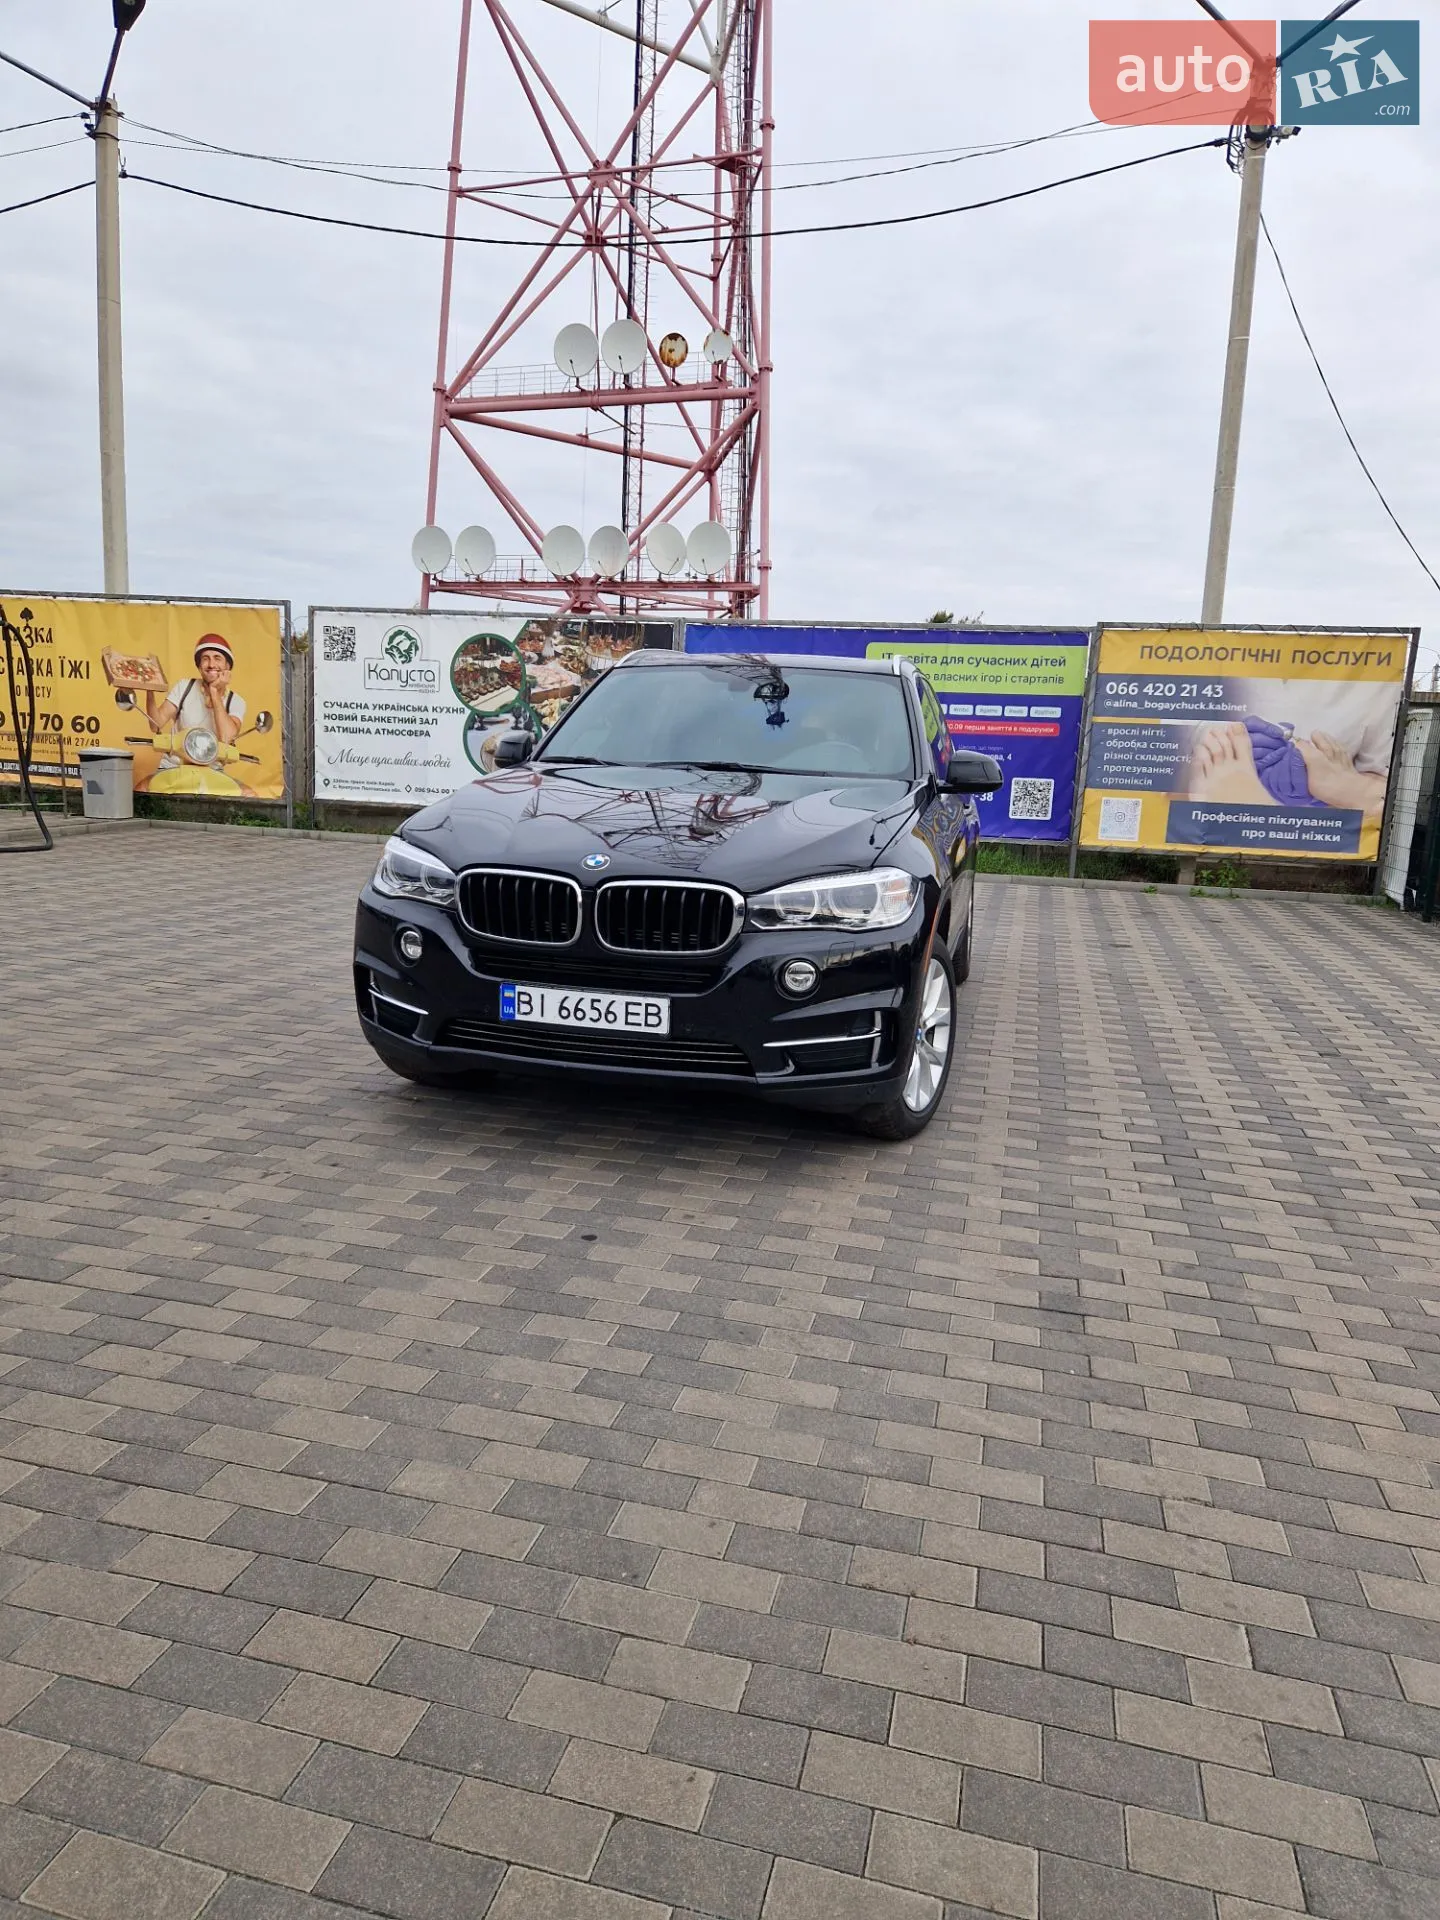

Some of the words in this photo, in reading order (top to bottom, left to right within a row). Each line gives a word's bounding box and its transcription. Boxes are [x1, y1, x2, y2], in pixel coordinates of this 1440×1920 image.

[940, 655, 964, 666] для
[967, 656, 1027, 669] сучасних
[1030, 655, 1066, 668] дітей
[1140, 644, 1281, 663] ПОДОЛОГІЧНІ
[1291, 649, 1392, 666] ПОСЛУГИ
[58, 656, 89, 679] ЇЖІ
[368, 663, 436, 688] Капуста
[933, 673, 977, 682] власних
[981, 672, 1001, 684] ігор
[1010, 673, 1065, 685] стартапів
[1105, 682, 1139, 695] 066
[1142, 683, 1176, 697] 420
[1180, 684, 1198, 697] 21
[1201, 684, 1224, 698] 43
[323, 701, 369, 710] СУЧАСНА
[372, 702, 429, 713] УКРАЇНСЬКА
[431, 707, 466, 715] КУХНЯ
[1103, 698, 1248, 712] @alina_bogaychuck.kabinet
[40, 712, 63, 732] 70
[71, 715, 100, 734] 60
[323, 712, 358, 722] НОВИЙ
[360, 714, 417, 725] БАНКЕТНИЙ
[419, 717, 438, 726] ЗАЛ
[323, 725, 372, 735] ЗАТИШНА
[374, 729, 431, 738] АТМОСФЕРА
[1107, 727, 1140, 737] врослі
[1141, 728, 1167, 737] нігті;
[75, 737, 100, 748] 27/49
[1105, 739, 1147, 751] обробка
[1149, 742, 1179, 750] стопи
[328, 748, 370, 766] Місце
[371, 752, 417, 768] щасливих
[419, 754, 452, 768] людей
[1007, 753, 1012, 761] 4
[1103, 752, 1133, 761] різної
[1134, 754, 1192, 764] складності;
[1103, 764, 1174, 775] протезування;
[1102, 776, 1153, 786] ортоніксія
[1191, 809, 1266, 825] Професійне
[1268, 815, 1342, 830] піклування
[1241, 828, 1265, 840] про
[1268, 829, 1299, 840] ваші
[1302, 830, 1341, 843] ніжки
[503, 1005, 515, 1015] UA
[516, 991, 545, 1018] BI
[558, 995, 618, 1024] 6656
[624, 1002, 662, 1028] EB
